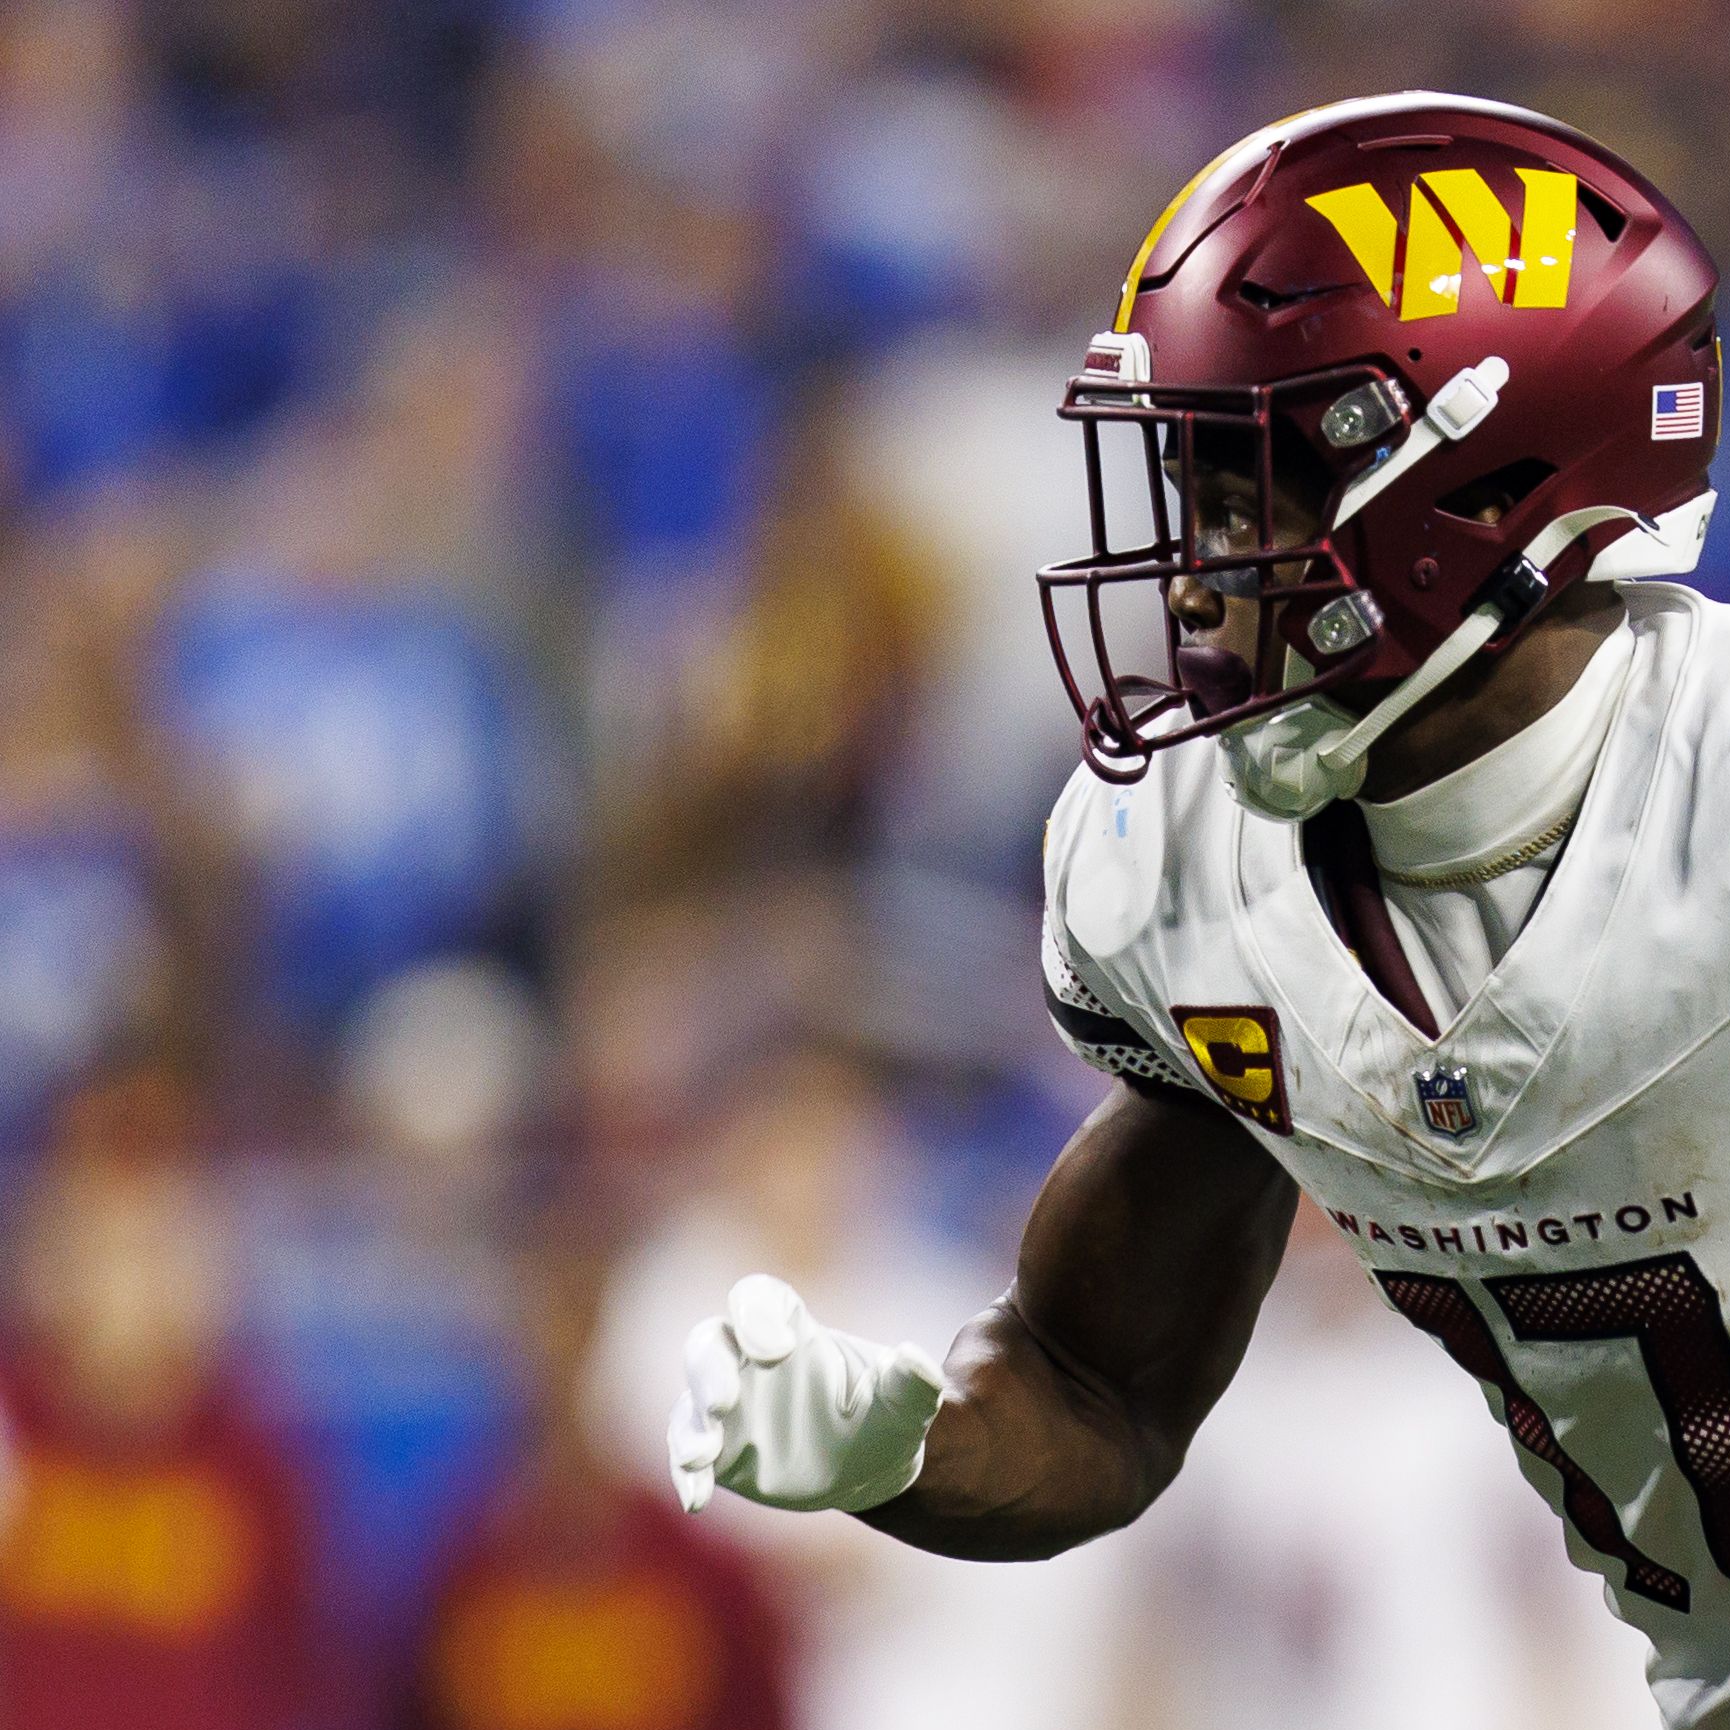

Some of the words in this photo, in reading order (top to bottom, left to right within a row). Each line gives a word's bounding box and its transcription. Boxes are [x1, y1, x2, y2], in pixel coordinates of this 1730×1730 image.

[1304, 168, 1577, 322] W
[1183, 1017, 1274, 1102] C
[1426, 1099, 1472, 1131] NFL
[1328, 1192, 1698, 1253] WASHINGTON
